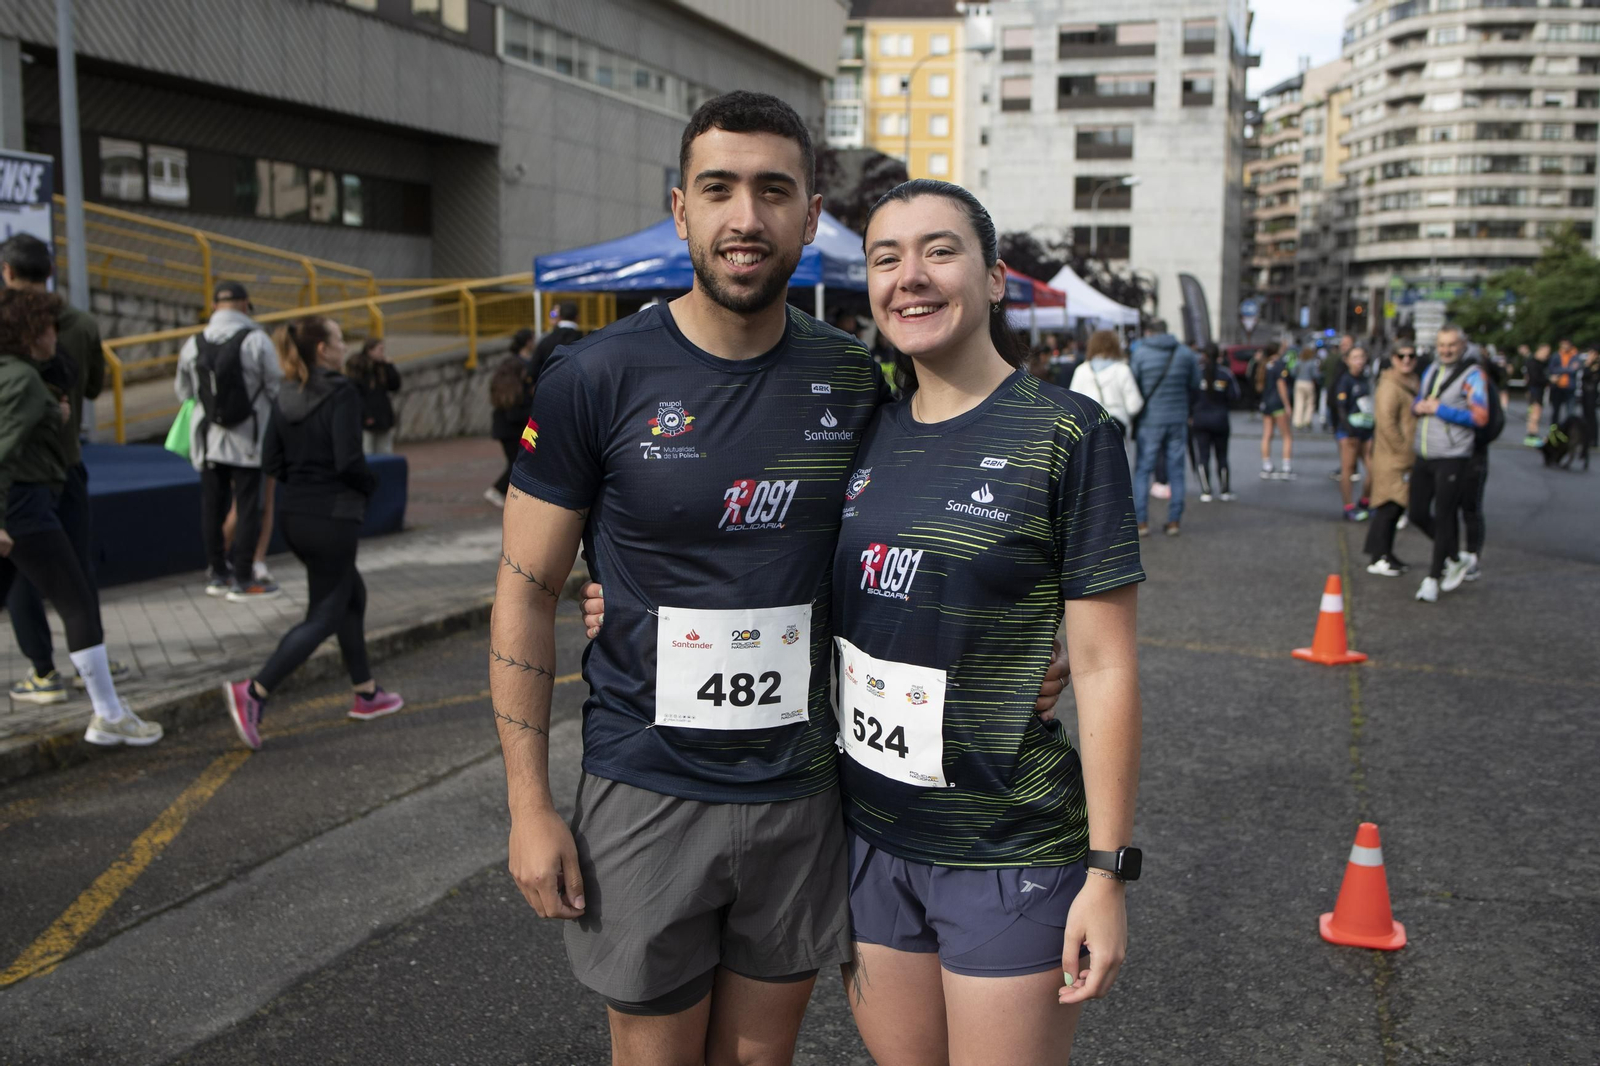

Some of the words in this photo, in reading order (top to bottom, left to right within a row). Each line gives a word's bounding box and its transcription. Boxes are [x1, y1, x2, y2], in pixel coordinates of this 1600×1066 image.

[0, 158, 45, 204] NSE
[812, 383, 831, 394] 42K
[659, 400, 682, 408] mupol
[804, 430, 854, 441] Santander
[640, 442, 662, 460] 75
[980, 457, 1007, 469] 42K
[945, 500, 1011, 522] Santander
[725, 522, 786, 532] SOLIDARIA
[867, 588, 909, 601] SOLIDARIA
[732, 629, 761, 641] 200
[672, 640, 713, 649] Santander
[697, 671, 781, 707] 482
[853, 707, 909, 759] 524
